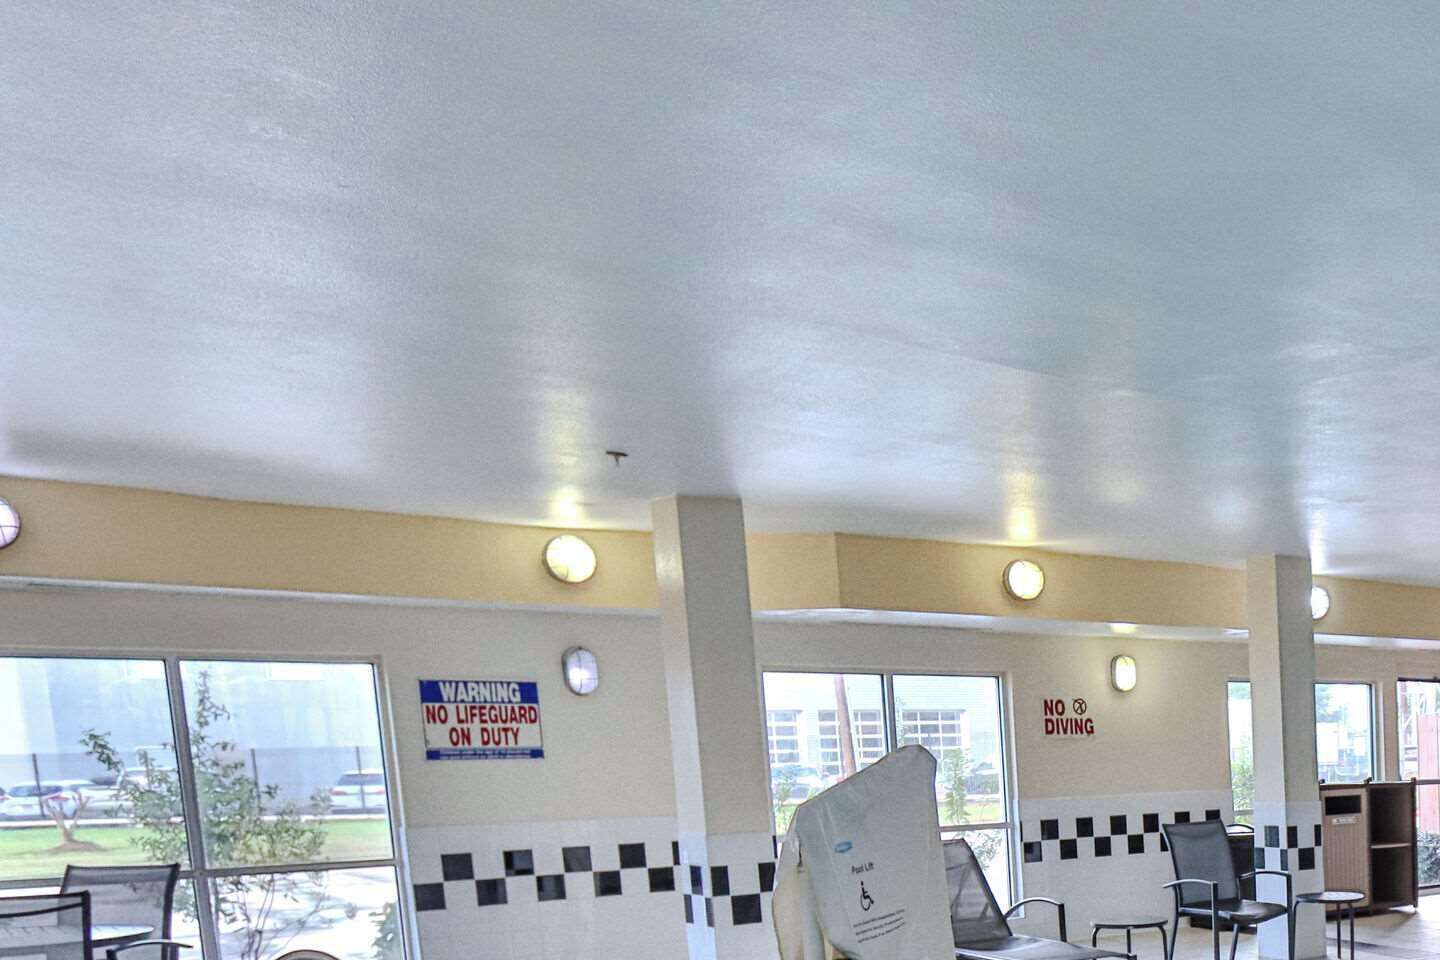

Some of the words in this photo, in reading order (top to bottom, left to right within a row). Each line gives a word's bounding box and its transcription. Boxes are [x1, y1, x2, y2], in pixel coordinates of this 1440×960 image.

[439, 681, 521, 702] WARNING
[425, 704, 448, 724] NO
[456, 704, 538, 724] LIFEGUARD
[1043, 698, 1065, 716] NO
[1045, 717, 1094, 735] DIVING
[449, 727, 471, 746] ON
[480, 727, 519, 746] DUTY
